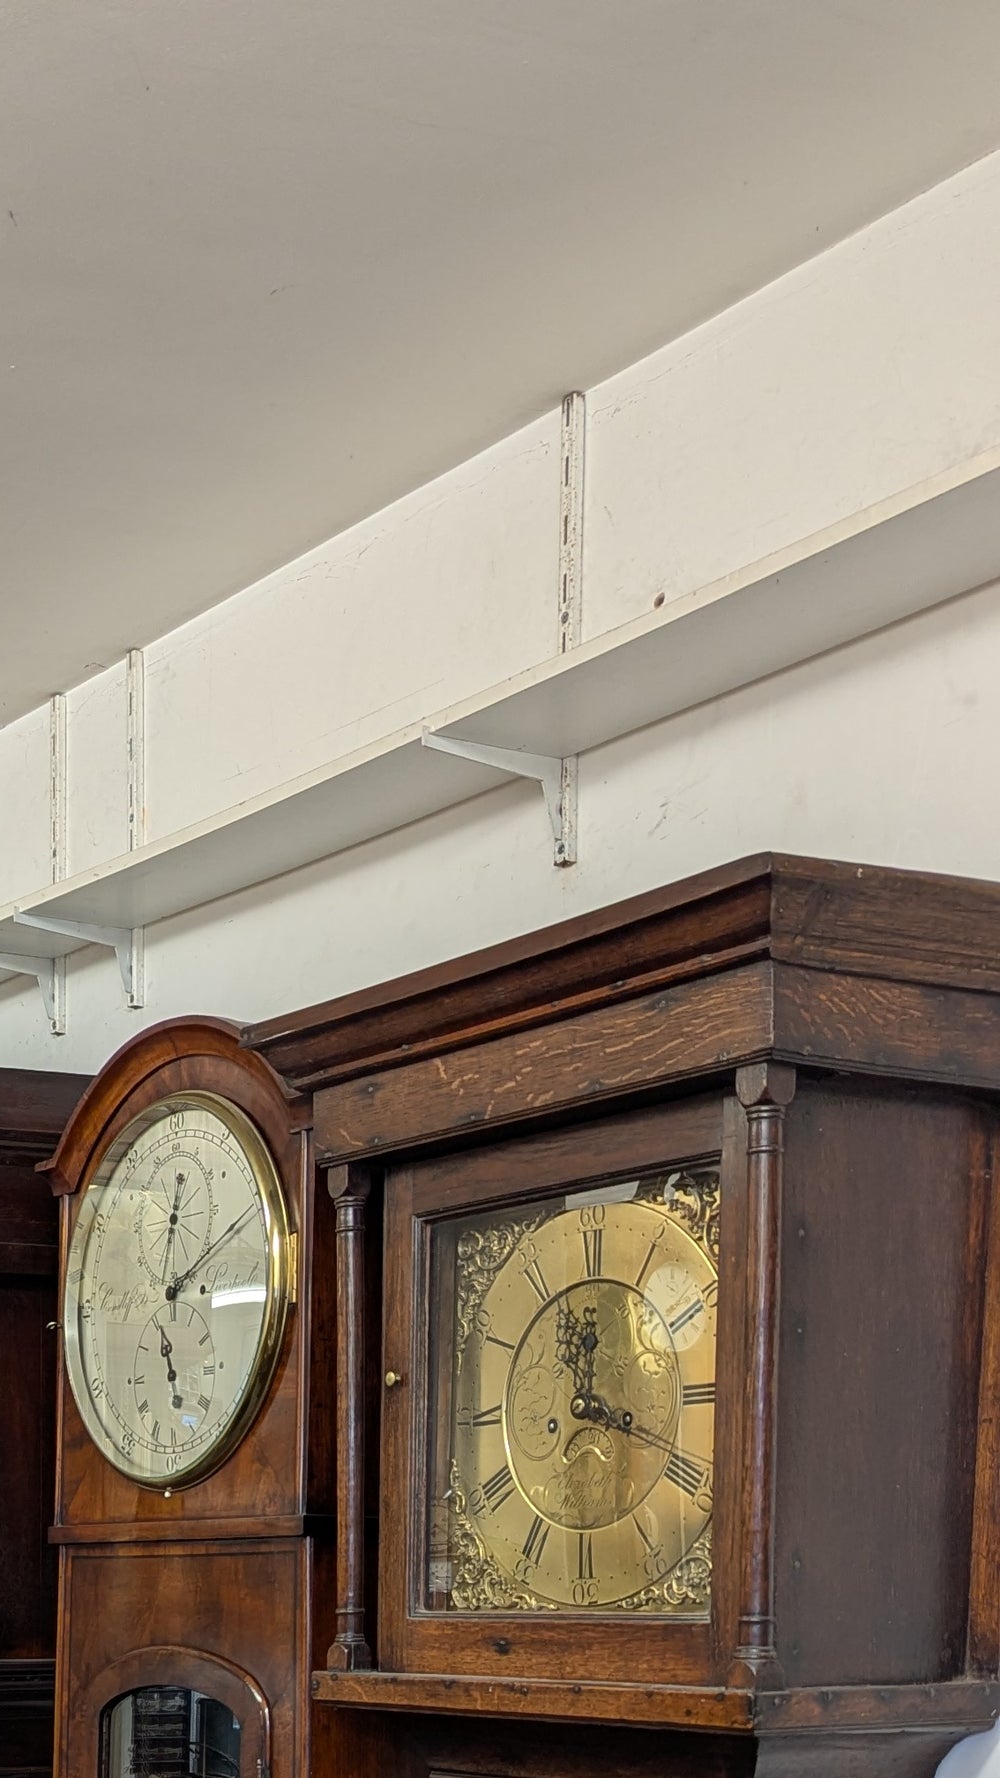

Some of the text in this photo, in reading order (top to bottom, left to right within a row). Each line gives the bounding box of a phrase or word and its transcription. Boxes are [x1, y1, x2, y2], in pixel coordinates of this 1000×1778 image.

[169, 1112, 185, 1132] 60
[579, 1204, 606, 1227] 60
[579, 1228, 604, 1280] XII
[682, 1382, 716, 1406] III
[572, 1583, 600, 1605] 30
